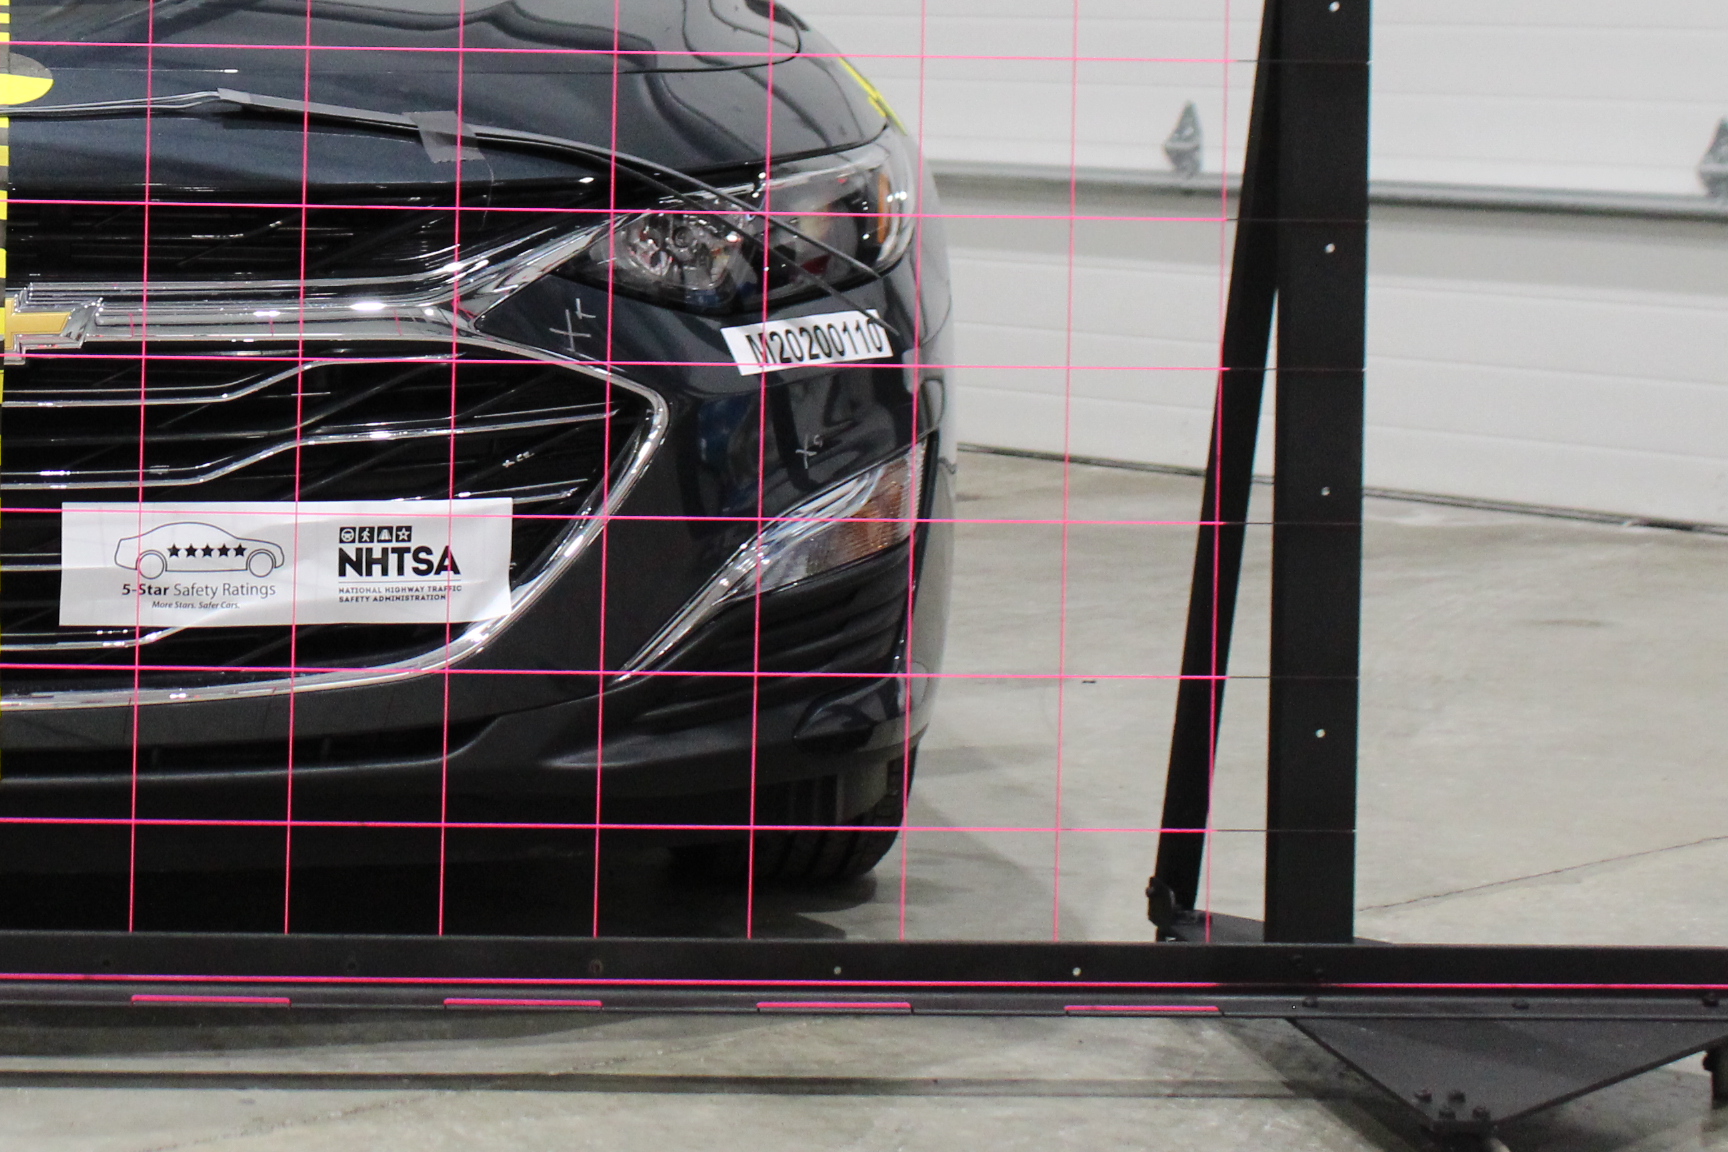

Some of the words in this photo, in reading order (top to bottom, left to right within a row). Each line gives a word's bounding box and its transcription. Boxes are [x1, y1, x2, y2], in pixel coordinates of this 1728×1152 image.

[746, 318, 884, 365] M20200110
[338, 545, 462, 577] NHTSA
[122, 582, 170, 596] 5-Star
[173, 583, 218, 599] Safety
[222, 582, 276, 599] Ratings
[338, 586, 382, 594] NATIONAL
[384, 586, 425, 594] HIGHWAY
[427, 585, 462, 593] TRAFFIC
[152, 601, 173, 609] More
[174, 601, 197, 609] Stars.
[198, 601, 218, 609] Safer
[219, 601, 240, 609] Cars.
[338, 595, 370, 603] SAFETY
[373, 594, 446, 603] ADMINISTRATION
